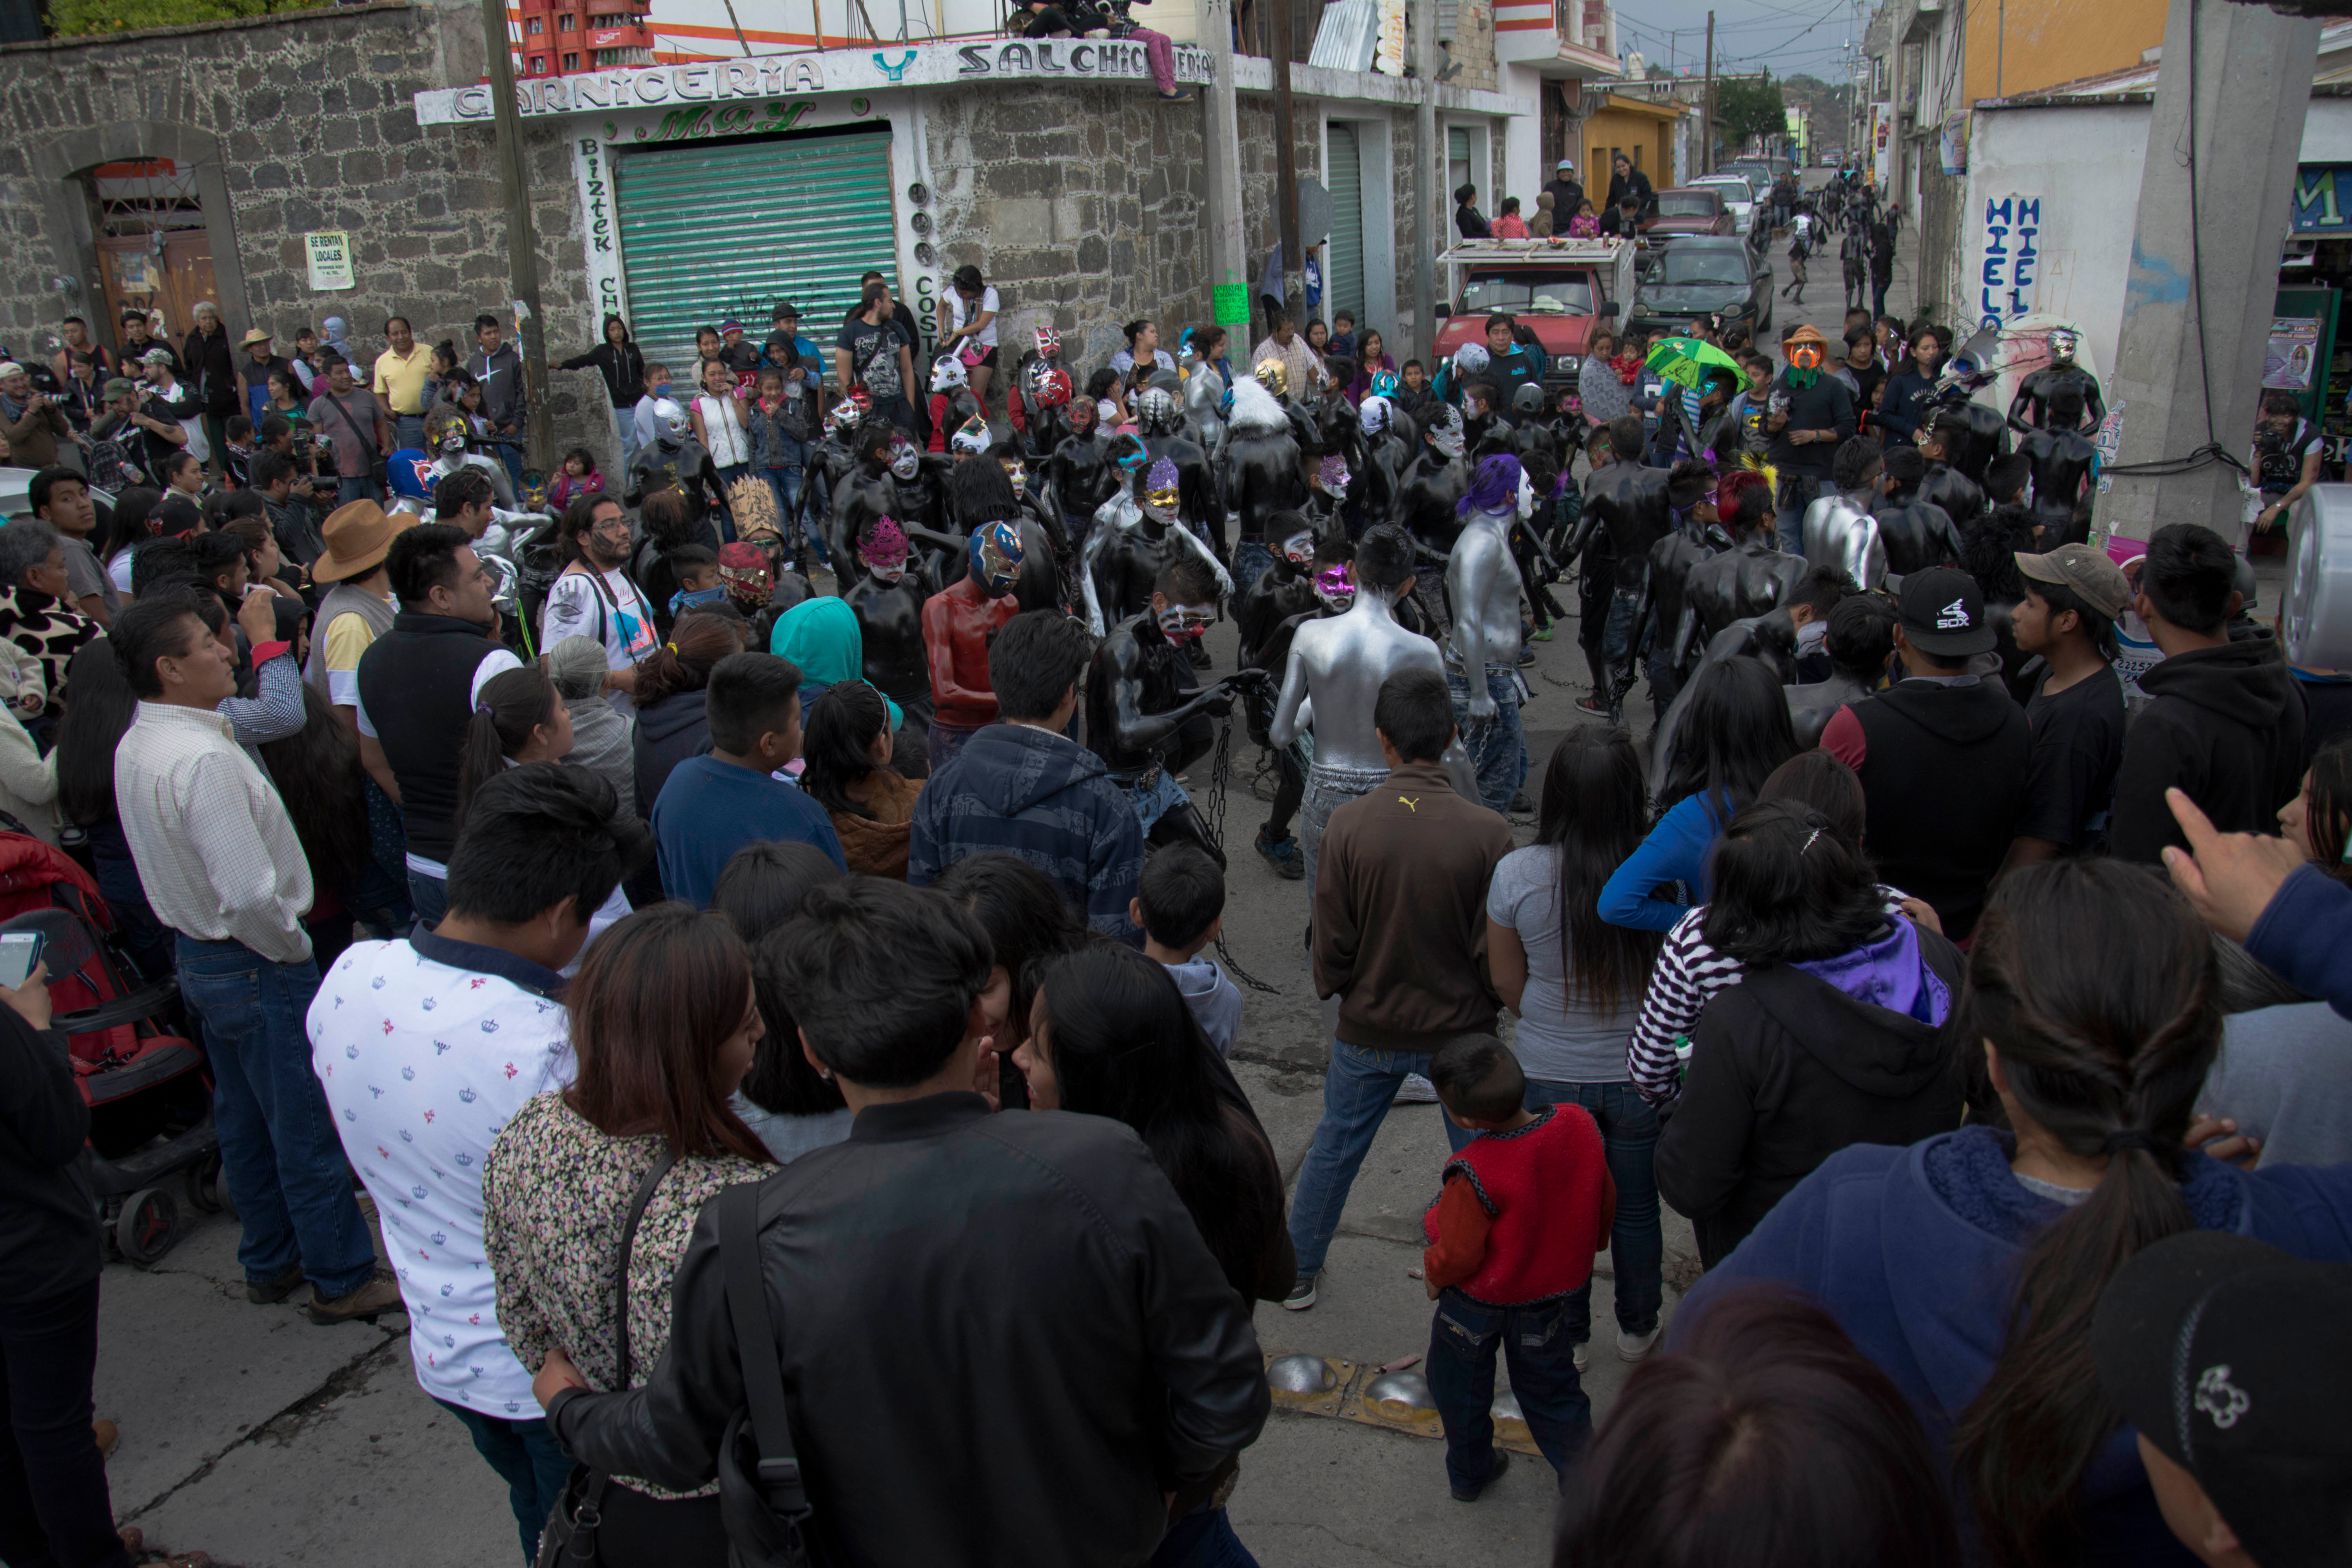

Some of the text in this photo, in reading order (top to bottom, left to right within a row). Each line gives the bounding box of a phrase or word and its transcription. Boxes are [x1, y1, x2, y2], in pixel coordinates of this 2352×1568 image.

[310, 234, 344, 248] SE RENTAN
[314, 249, 343, 262] LOCALES
[2012, 197, 2040, 322] HIEL
[1936, 617, 1970, 629] SOX
